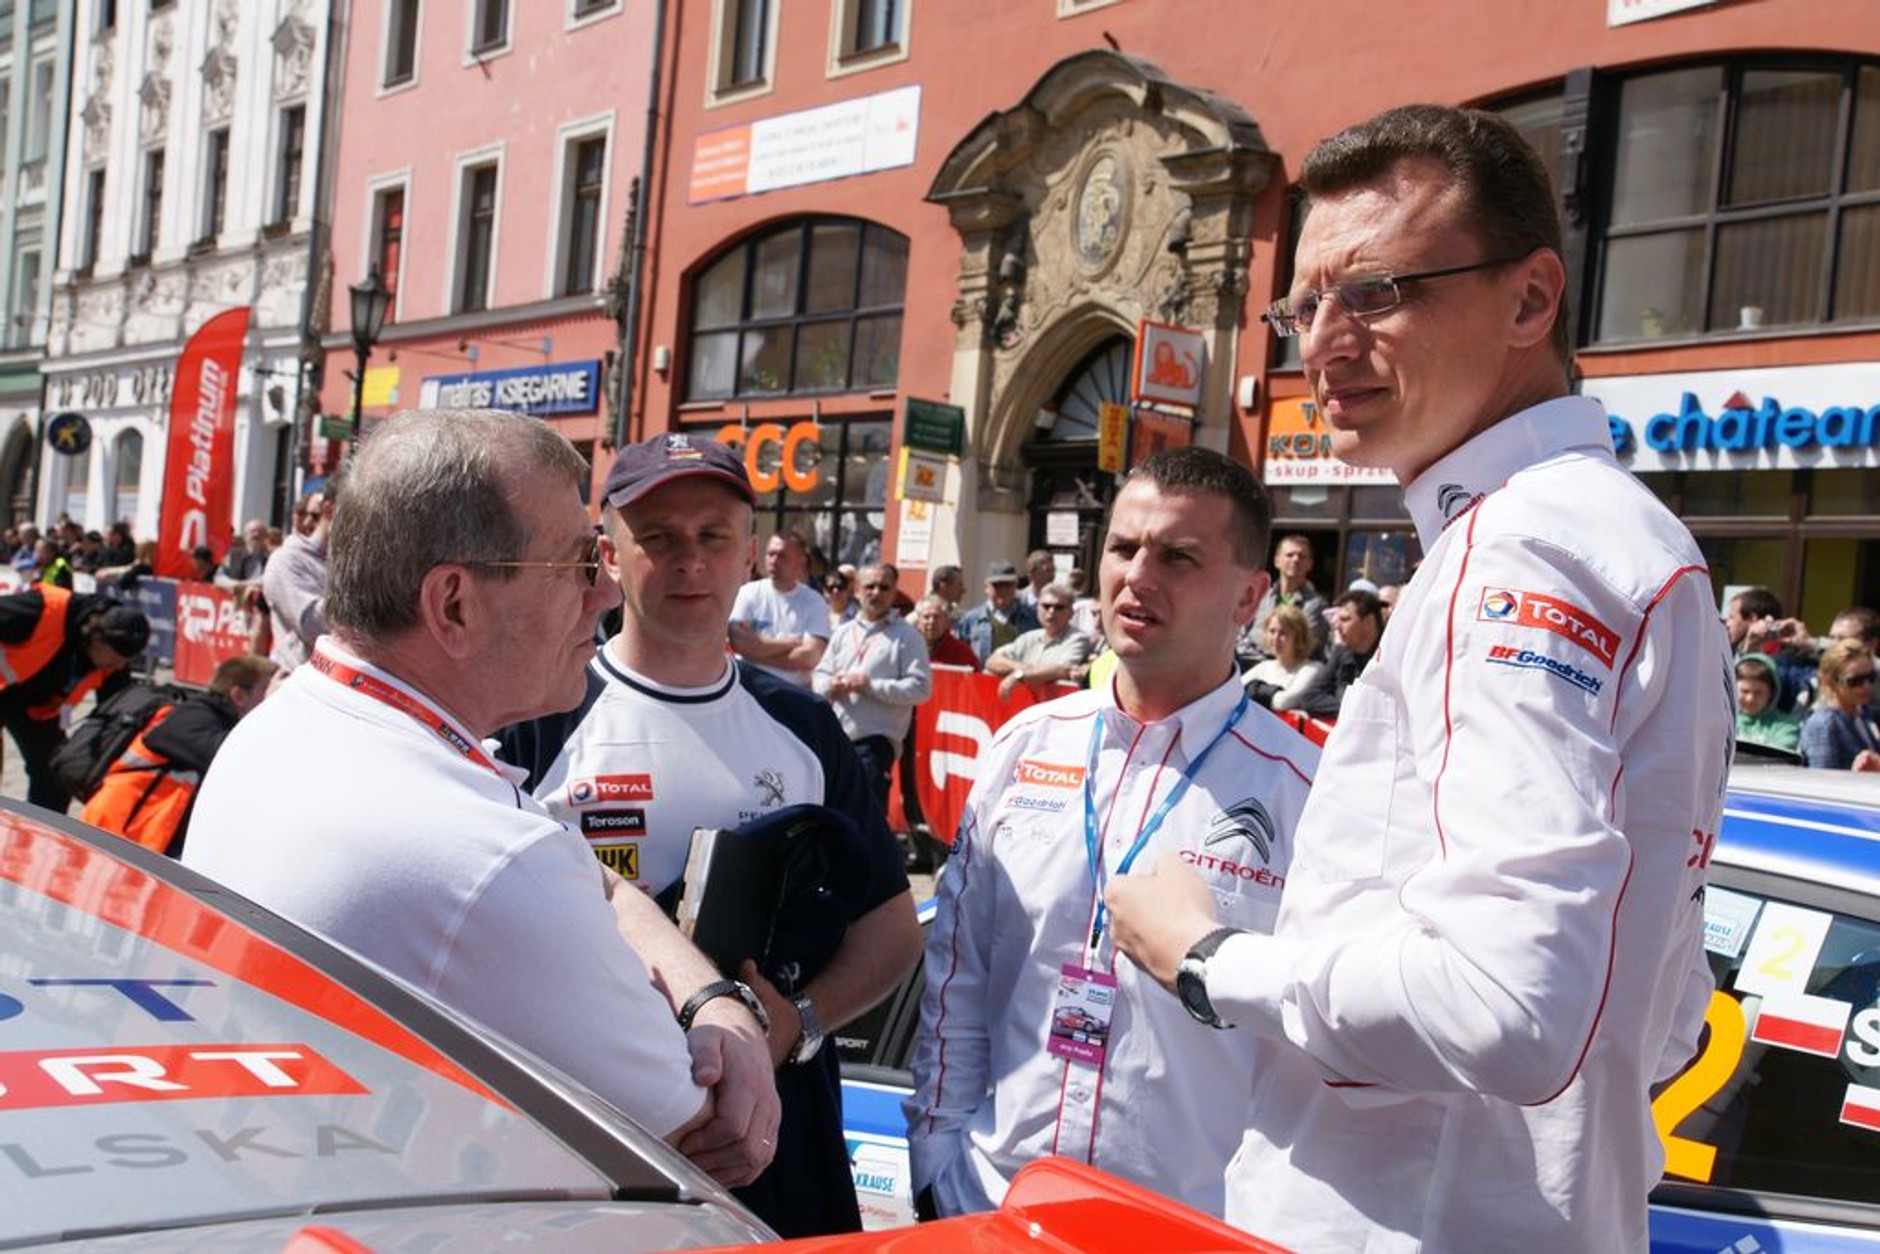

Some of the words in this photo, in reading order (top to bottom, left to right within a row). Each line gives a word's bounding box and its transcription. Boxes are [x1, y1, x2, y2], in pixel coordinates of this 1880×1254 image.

[496, 370, 588, 408] KSIĘGARNIE
[186, 357, 221, 504] Platinum
[1526, 600, 1612, 660] TOTAL
[1489, 645, 1602, 692] BFGoodrich
[599, 782, 653, 794] TOTAL
[1023, 764, 1081, 784] TOTAL
[588, 815, 639, 828] Teroson
[1758, 925, 1806, 981] 2
[0, 1051, 304, 1096] RT
